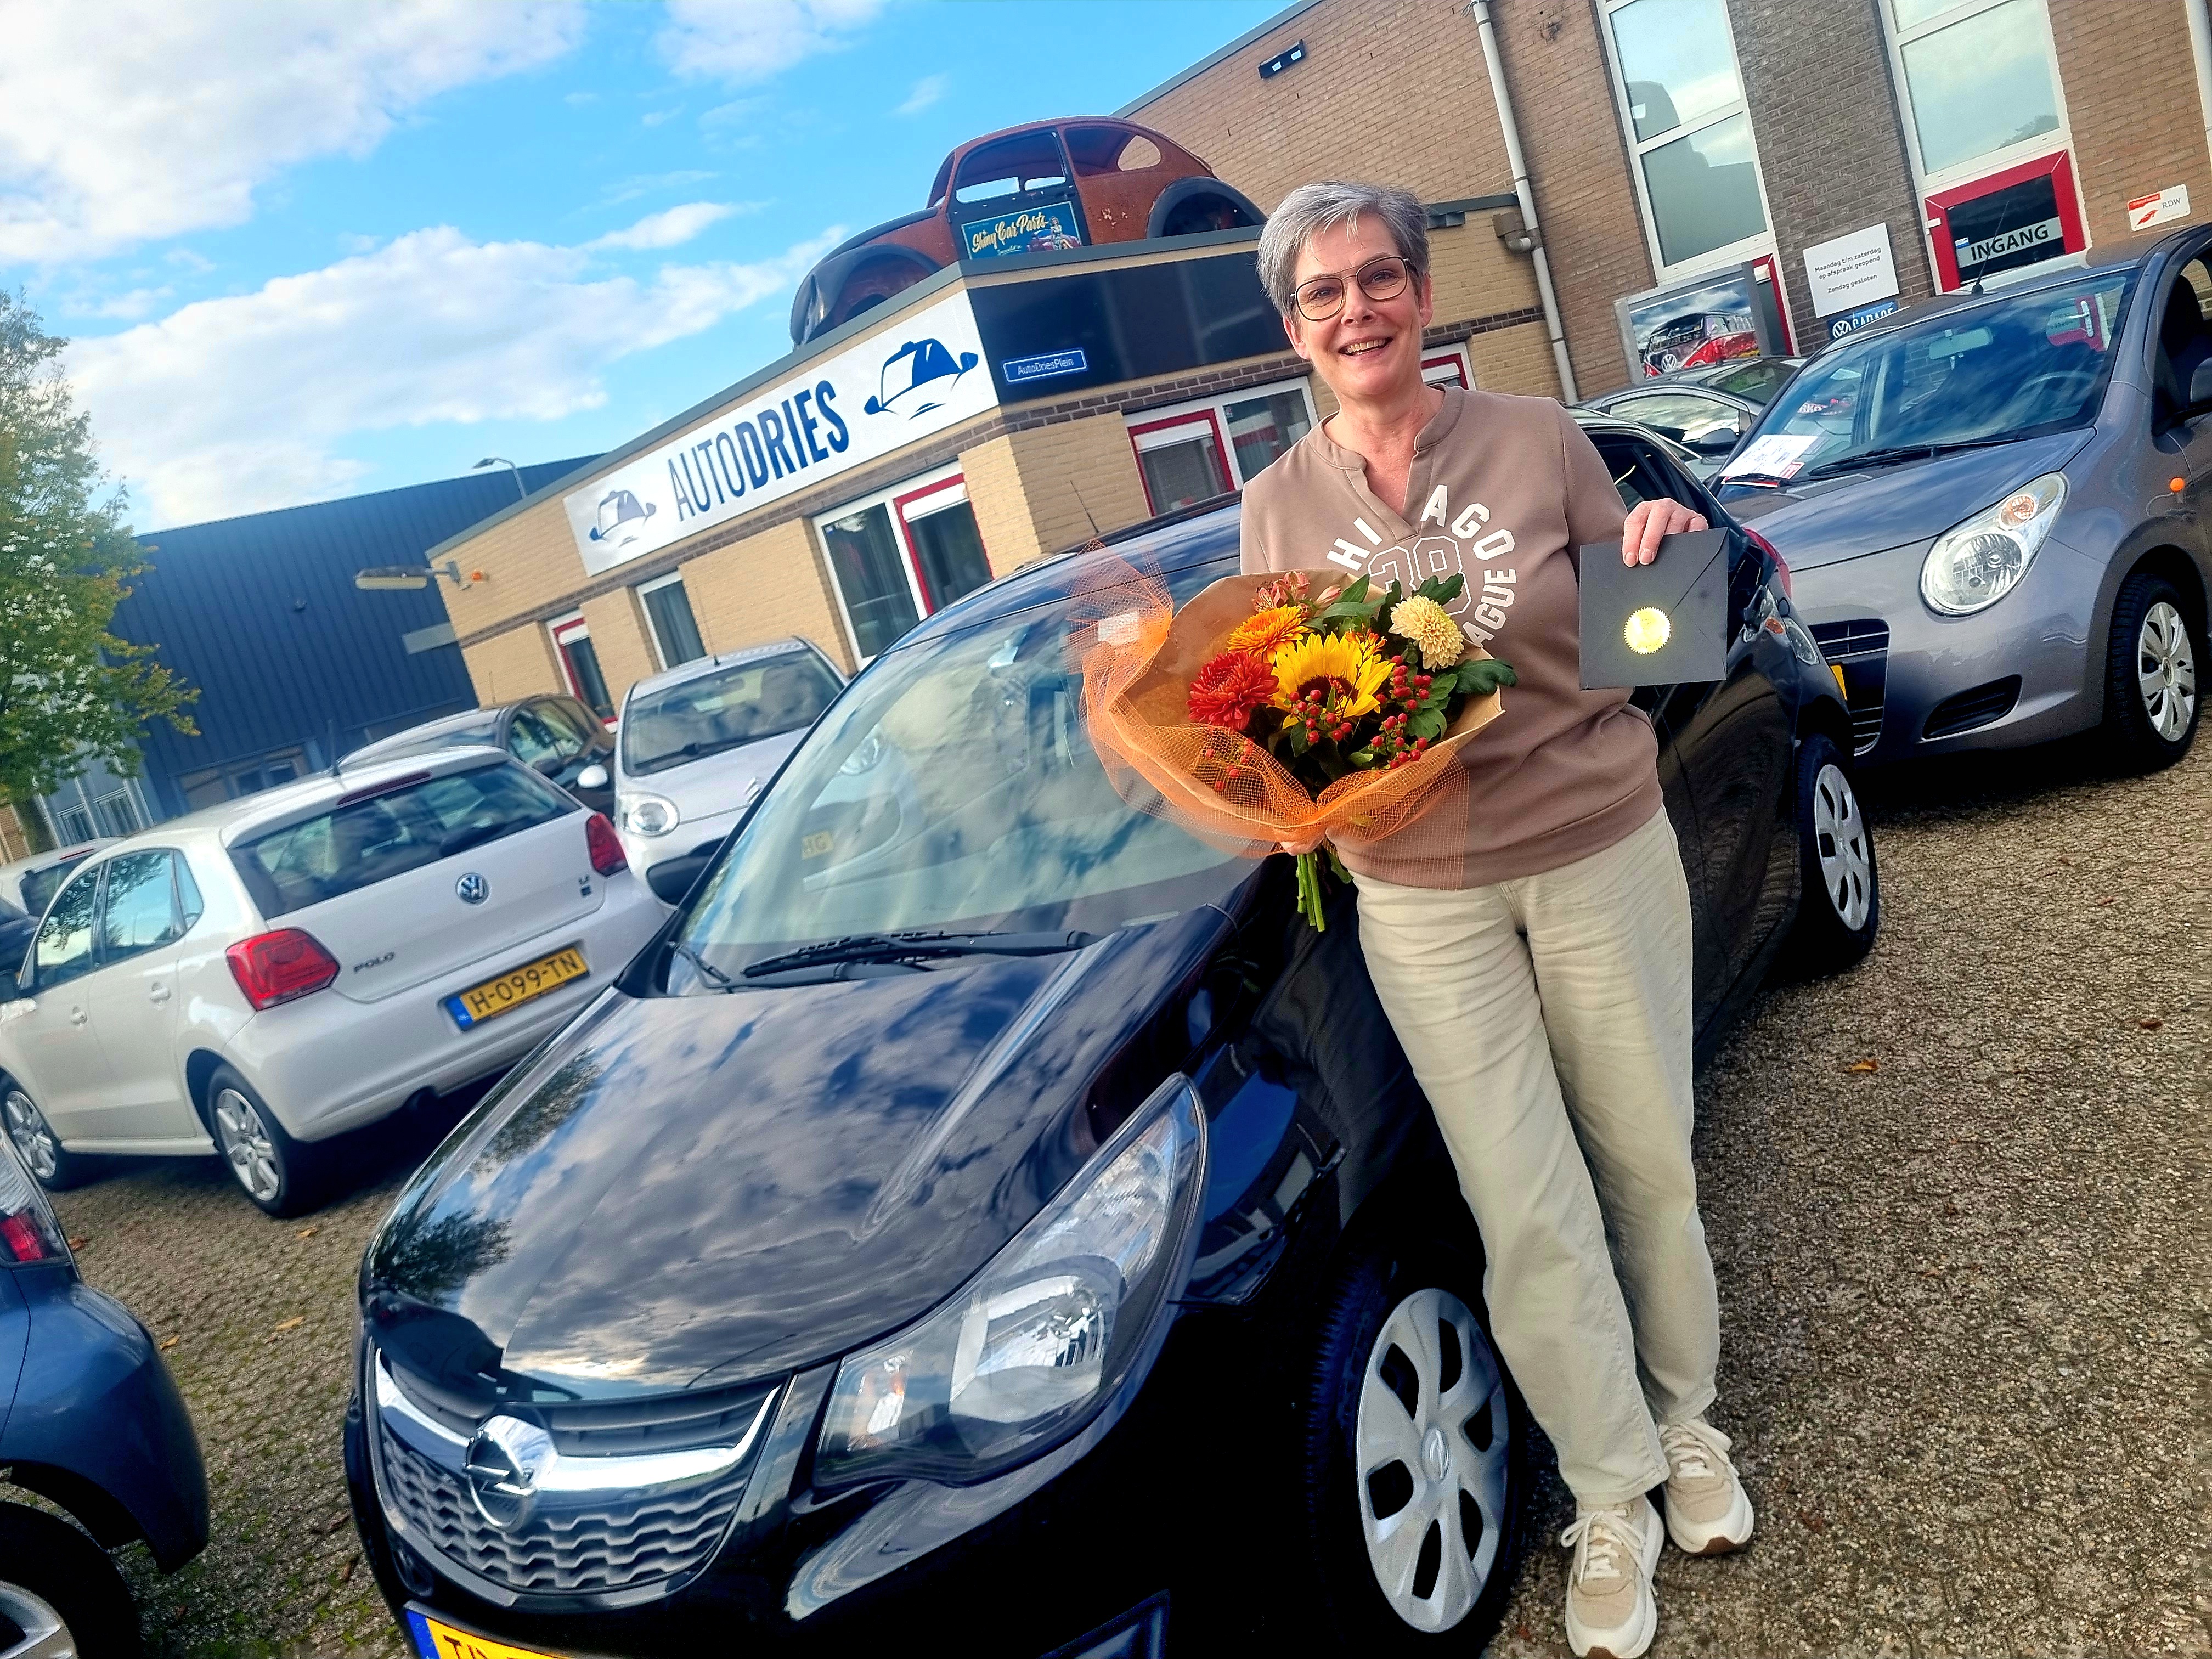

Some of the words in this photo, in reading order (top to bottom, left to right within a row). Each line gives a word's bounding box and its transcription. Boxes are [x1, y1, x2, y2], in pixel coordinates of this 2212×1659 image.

[2162, 198, 2181, 208] RDW
[995, 221, 1018, 245] Car
[1016, 212, 1049, 234] Parts
[1971, 224, 2050, 261] INGANG
[1815, 261, 1841, 272] Maandag
[1854, 247, 1881, 259] zaterdag
[1827, 265, 1853, 276] afspraak
[1855, 256, 1880, 269] geopend
[1828, 283, 1849, 293] Zondag
[1851, 274, 1877, 287] gesloten
[1017, 357, 1074, 376] AutoDriesPlein
[668, 380, 850, 522] AUTODRIES
[353, 951, 396, 974] POLO
[470, 953, 579, 1015] H-099-TN
